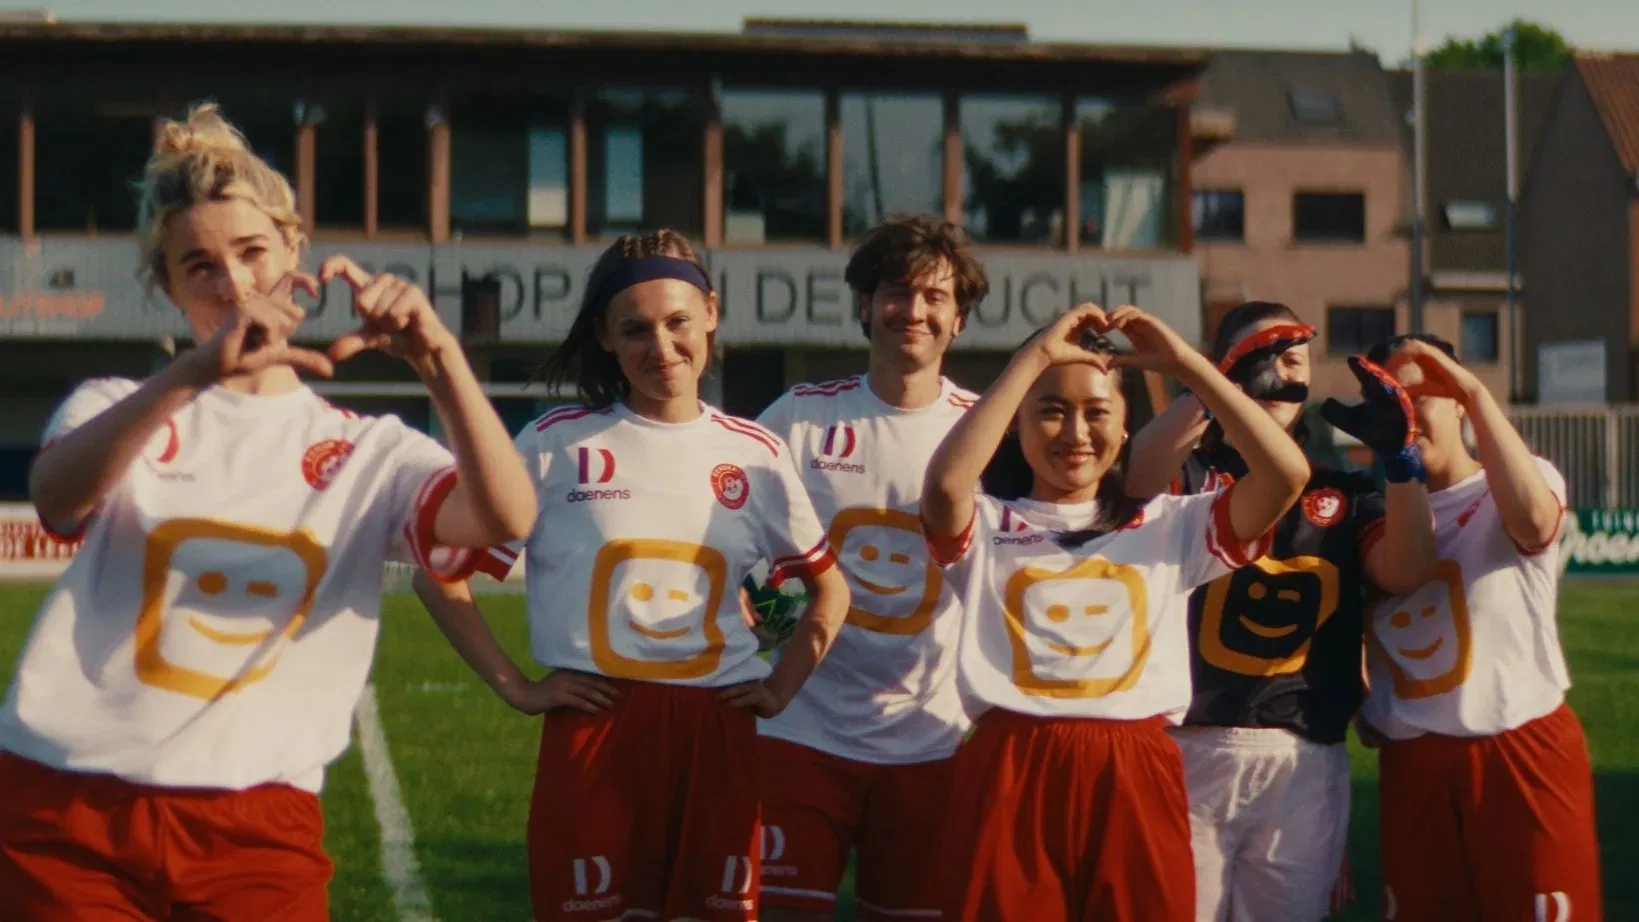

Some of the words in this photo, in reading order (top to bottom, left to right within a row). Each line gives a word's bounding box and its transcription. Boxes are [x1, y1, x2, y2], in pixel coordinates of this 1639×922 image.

[755, 270, 862, 326] DE
[974, 271, 1153, 328] UCHT
[810, 458, 866, 475] daenens
[566, 487, 631, 503] daenens
